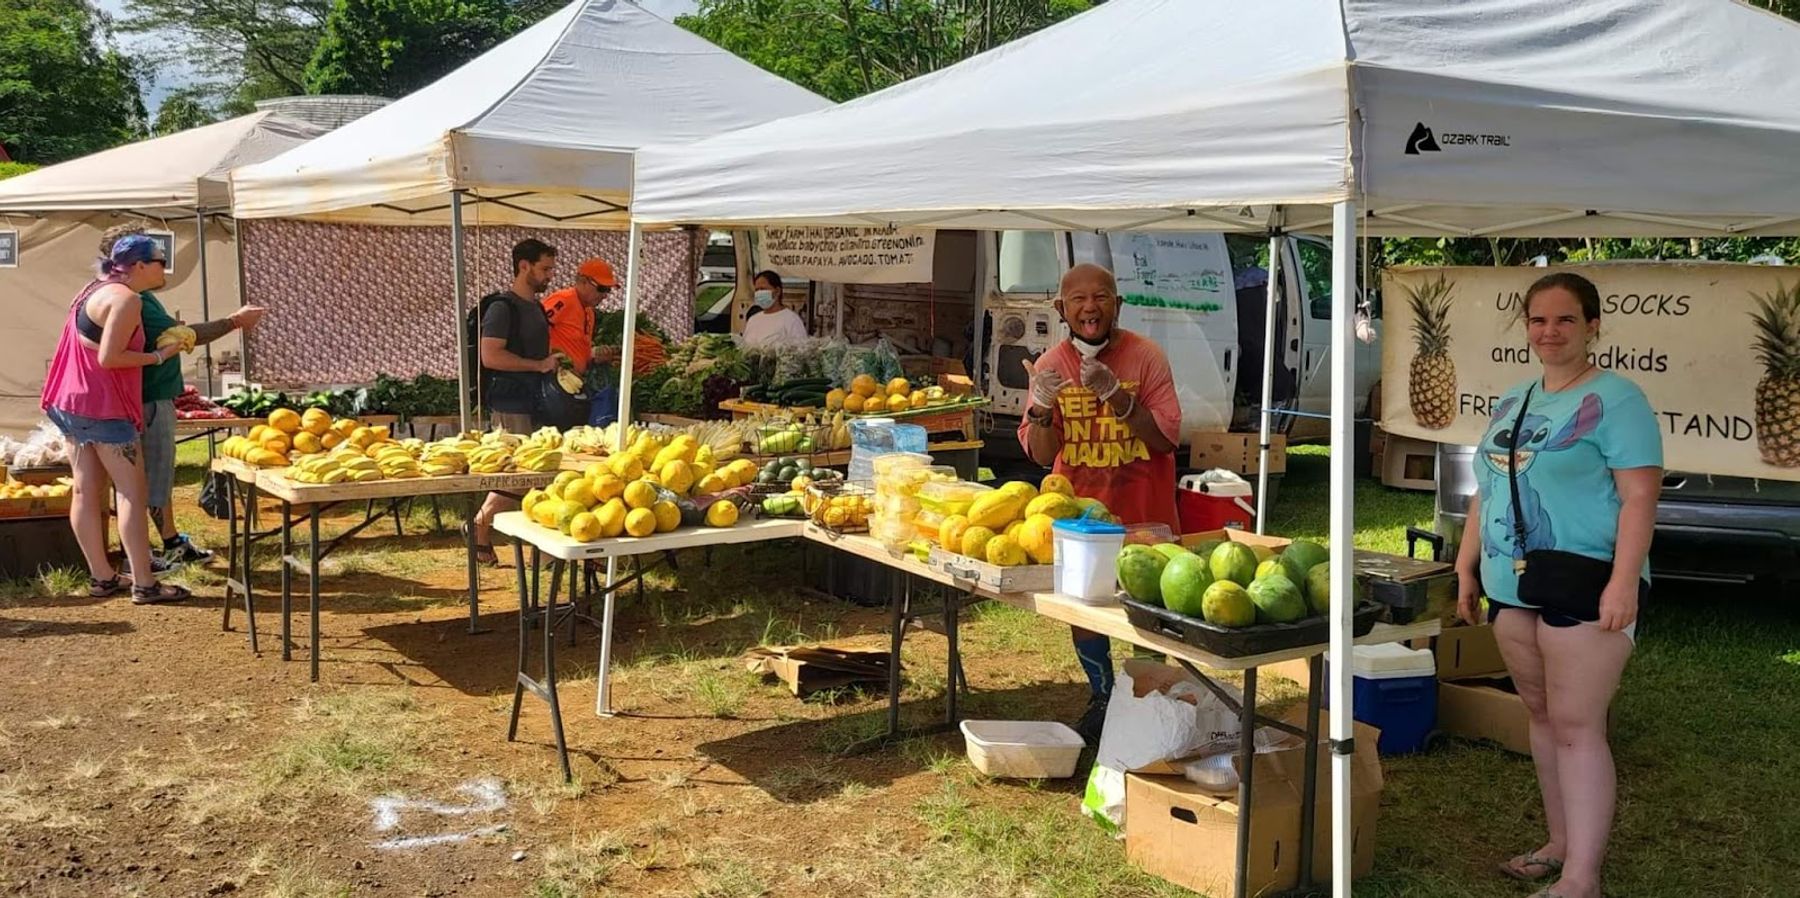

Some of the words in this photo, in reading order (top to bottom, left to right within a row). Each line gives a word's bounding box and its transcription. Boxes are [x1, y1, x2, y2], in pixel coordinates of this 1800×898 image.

[1602, 294, 1692, 316] SOCKS
[1491, 345, 1531, 364] and
[1655, 410, 1753, 441] TAND
[1061, 437, 1151, 468] MAUNA
